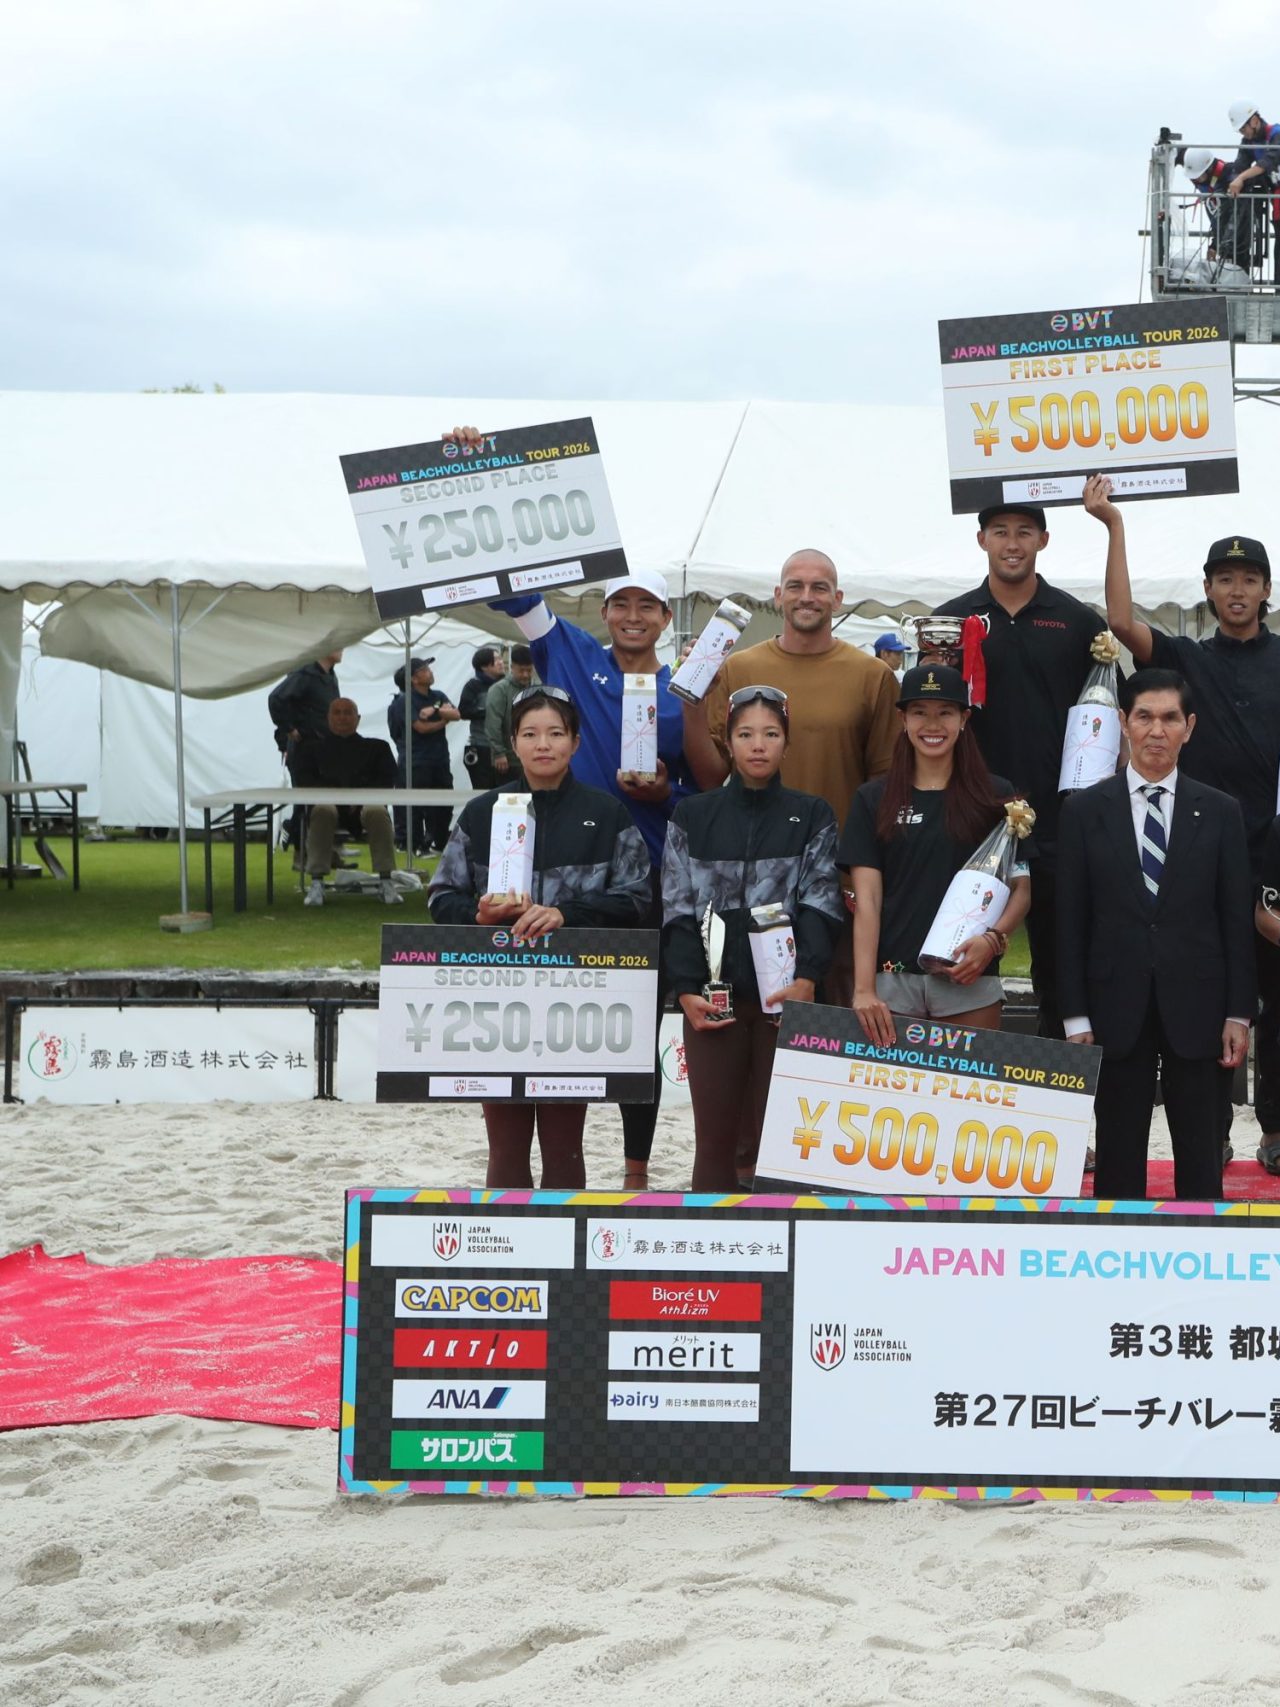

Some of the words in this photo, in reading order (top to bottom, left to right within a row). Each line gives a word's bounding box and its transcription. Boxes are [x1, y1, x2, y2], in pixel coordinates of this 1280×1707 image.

[1072, 310, 1114, 331] BVT
[951, 344, 996, 360] JAPAN
[1000, 334, 1139, 356] BEACHVOLLEYBALL
[1143, 330, 1182, 343] TOUR
[1187, 326, 1219, 339] 2026
[1009, 356, 1077, 380] FIRST
[1085, 350, 1162, 374] PLACE
[970, 381, 1210, 456] ¥500,000
[356, 473, 397, 489] JAPAN
[400, 454, 524, 482] BEACHVOLLEYBALL
[526, 448, 560, 461] TOUR
[563, 442, 591, 455] 2026
[400, 476, 485, 503] SECOND
[491, 464, 558, 488] PLACE
[382, 489, 596, 569] ¥250,000
[1032, 619, 1066, 629] TOYOTA
[511, 932, 553, 948] BVT
[391, 952, 436, 963] JAPAN
[441, 952, 574, 966] BEACHVOLLEYBALL
[579, 955, 615, 967] TOUR
[619, 956, 649, 967] 2026
[434, 968, 527, 987] SECOND
[535, 969, 607, 988] PLACE
[405, 1000, 633, 1057] ¥250,000
[929, 1026, 977, 1052] BVT
[89, 1049, 308, 1070] 霧島酒造株式会社
[789, 1033, 840, 1052] JAPAN
[845, 1042, 997, 1076] BEACHVOLLEYBALL
[1003, 1065, 1046, 1083] TOUR
[1050, 1072, 1085, 1089] 2026
[849, 1063, 926, 1092] FIRST
[932, 1076, 1018, 1107] PLACE
[792, 1096, 1058, 1194] ¥500,000
[436, 1223, 458, 1235] JVA
[468, 1226, 491, 1234] JAPAN
[468, 1236, 510, 1244] VOLLEYBALL
[468, 1246, 514, 1254] ASSOCIATION
[633, 1240, 784, 1256] 霧島酒造株式会社
[882, 1247, 1006, 1277] JAPAN
[401, 1285, 541, 1312] CAPCOM
[652, 1287, 694, 1301] Bioré
[698, 1289, 720, 1302] UV
[660, 1304, 709, 1315] Athlizm
[672, 1336, 699, 1344] メリット
[814, 1324, 841, 1337] JVA
[853, 1328, 883, 1337] JAPAN
[853, 1340, 907, 1350] VOLLEYBALL
[1108, 1322, 1213, 1361] 第3戦
[634, 1341, 733, 1368] merit
[853, 1352, 912, 1362] ASSOCIATION
[426, 1388, 482, 1410] ANA
[421, 1438, 513, 1463] サロンパス
